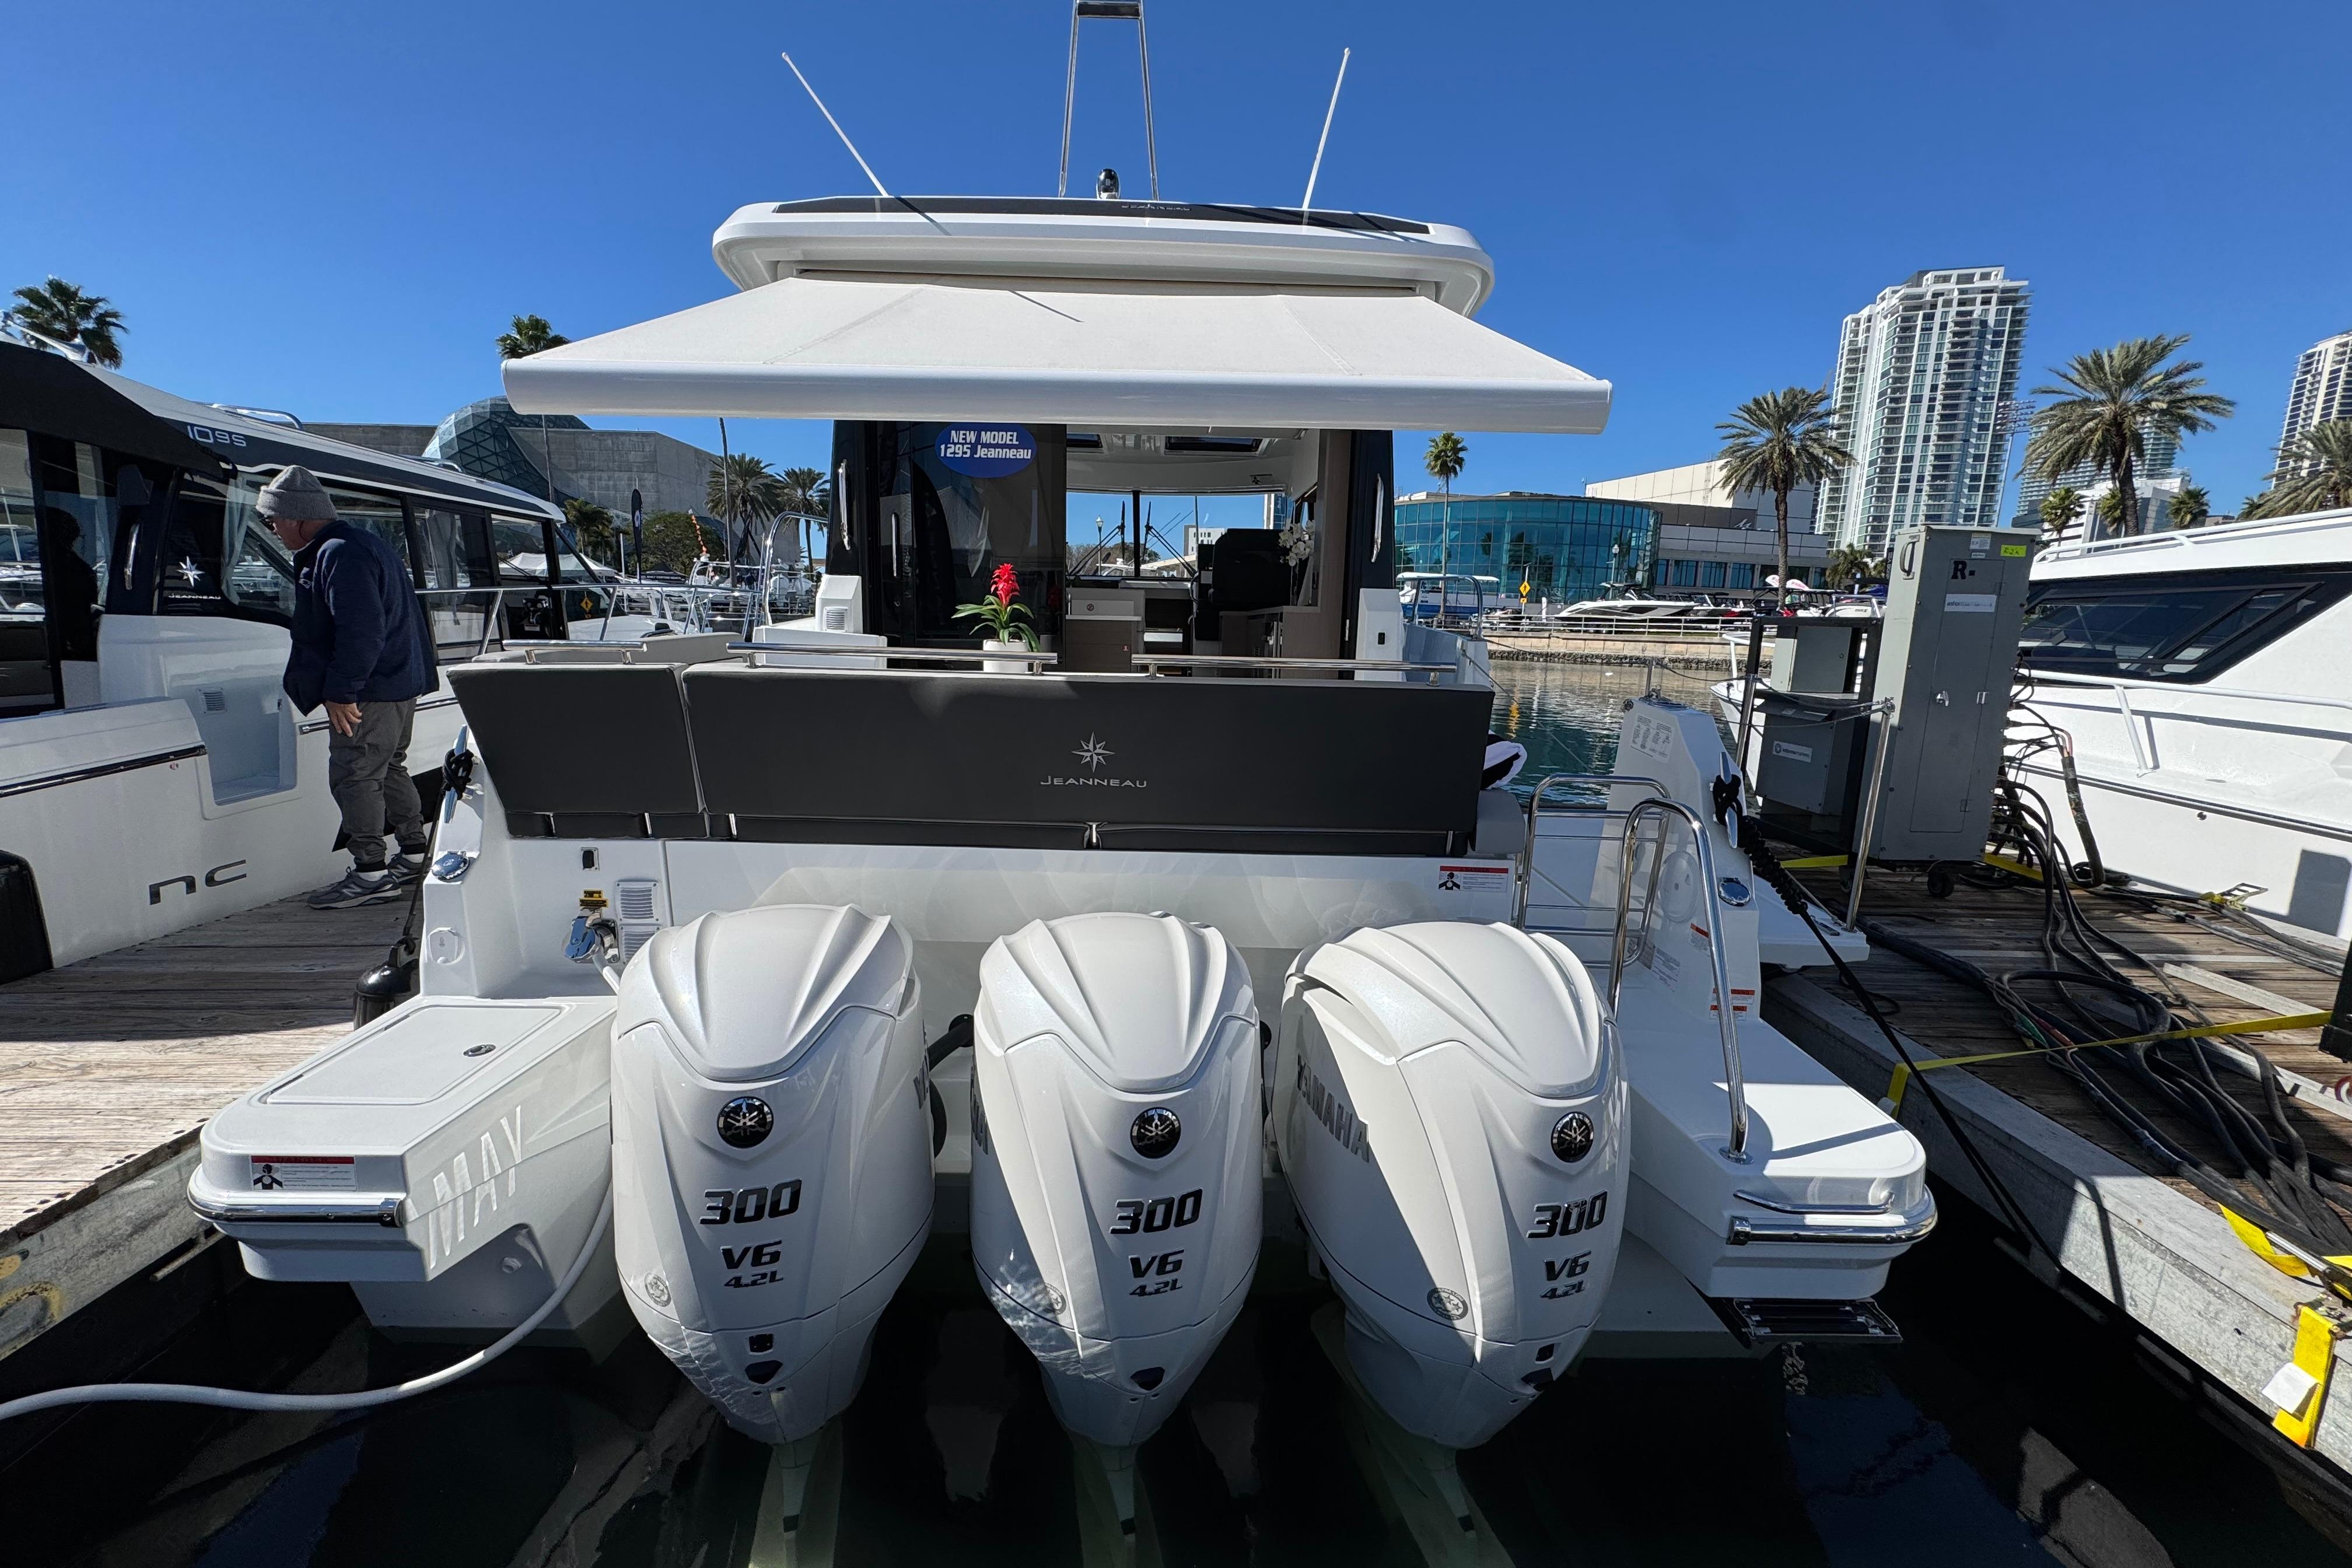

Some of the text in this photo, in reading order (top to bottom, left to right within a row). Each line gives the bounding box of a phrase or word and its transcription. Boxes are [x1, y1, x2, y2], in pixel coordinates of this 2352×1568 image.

[187, 425, 246, 447] 1095
[950, 430, 1019, 444] NEW MODEL
[940, 443, 1032, 459] 1295 Jeanneau
[1040, 775, 1147, 788] JEANNEAU
[1297, 1053, 1370, 1164] YAMAHA
[699, 1177, 803, 1224] 300
[1109, 1186, 1203, 1234] 300
[1525, 1189, 1608, 1238] 300
[720, 1238, 783, 1270] V6
[1128, 1247, 1185, 1279] V6
[1544, 1250, 1592, 1282] V6
[724, 1268, 784, 1289] 4.2L
[1129, 1276, 1183, 1297] 4.2L
[1539, 1279, 1586, 1300] 4.2L
